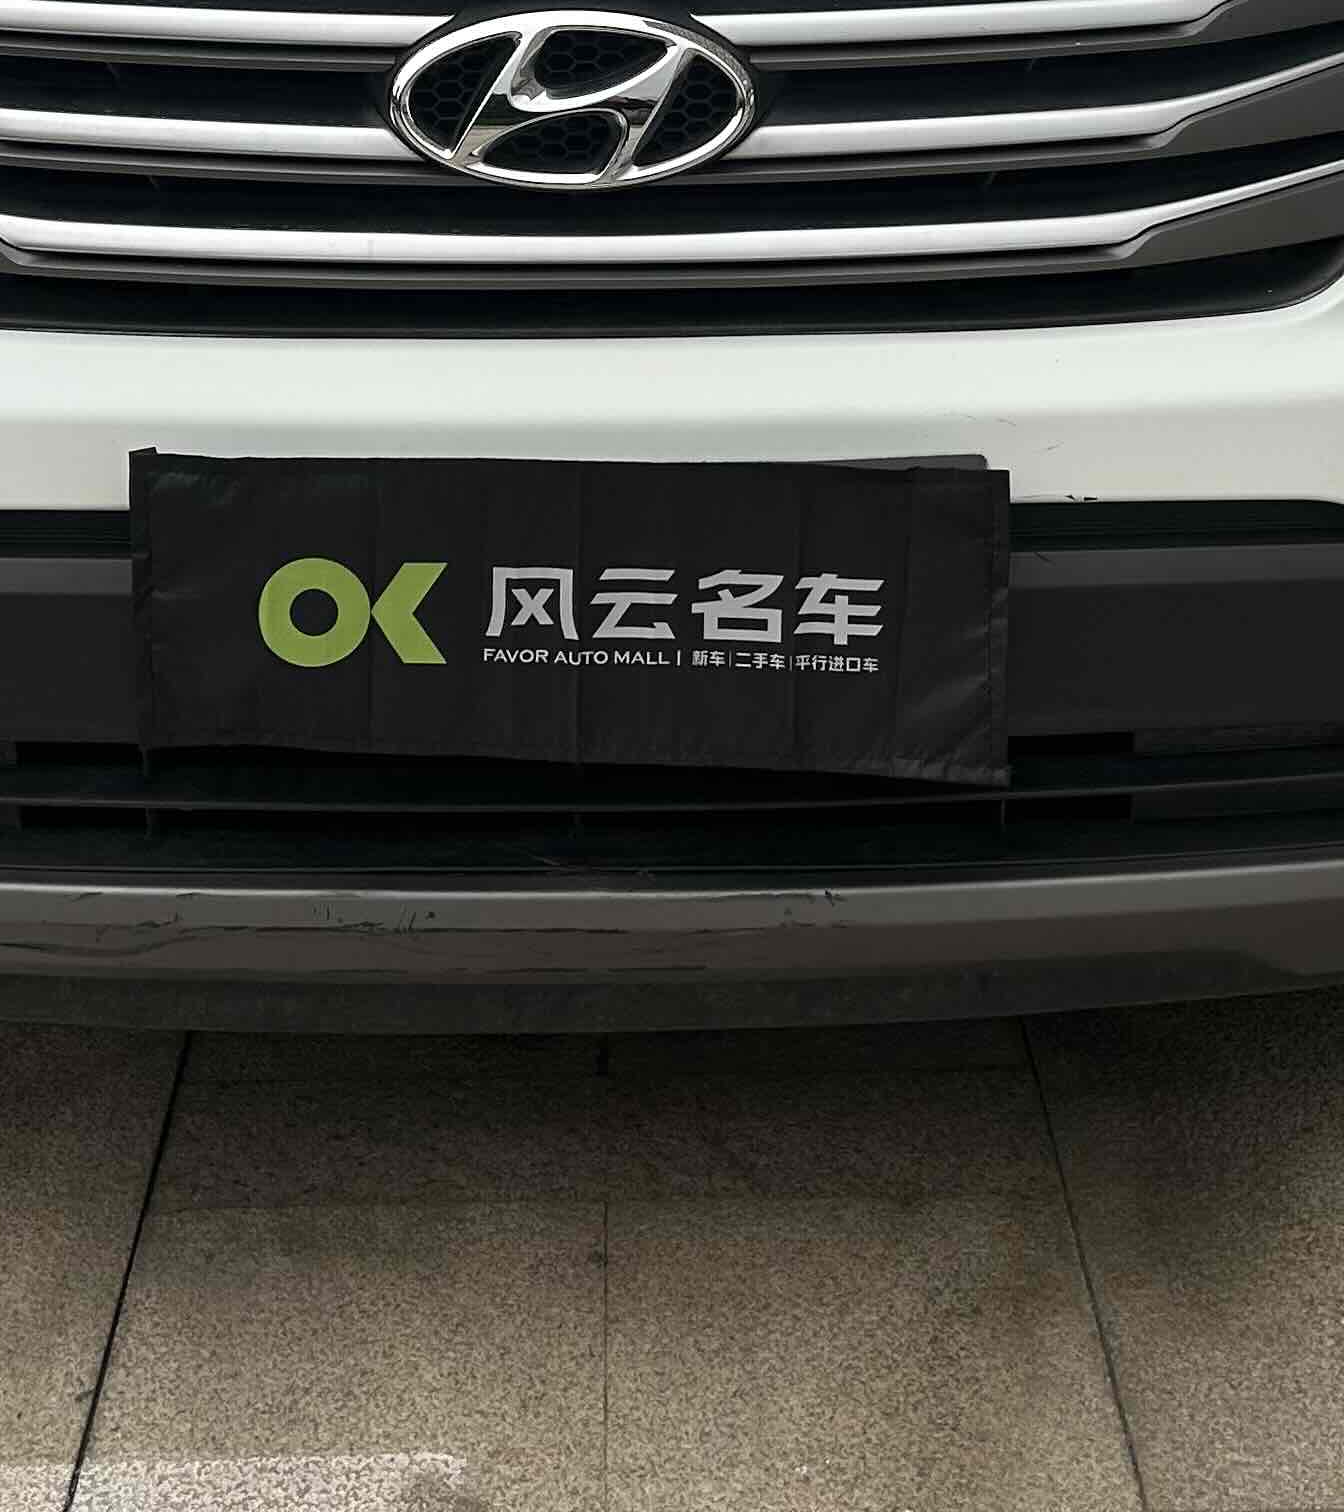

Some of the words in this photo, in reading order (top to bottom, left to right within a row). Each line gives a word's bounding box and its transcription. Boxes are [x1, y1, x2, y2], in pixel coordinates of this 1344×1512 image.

[258, 558, 447, 667] OK
[486, 566, 885, 646] 风云名车
[483, 648, 549, 664] FAVOR
[554, 650, 609, 666] AUTO
[614, 650, 670, 665] MALL
